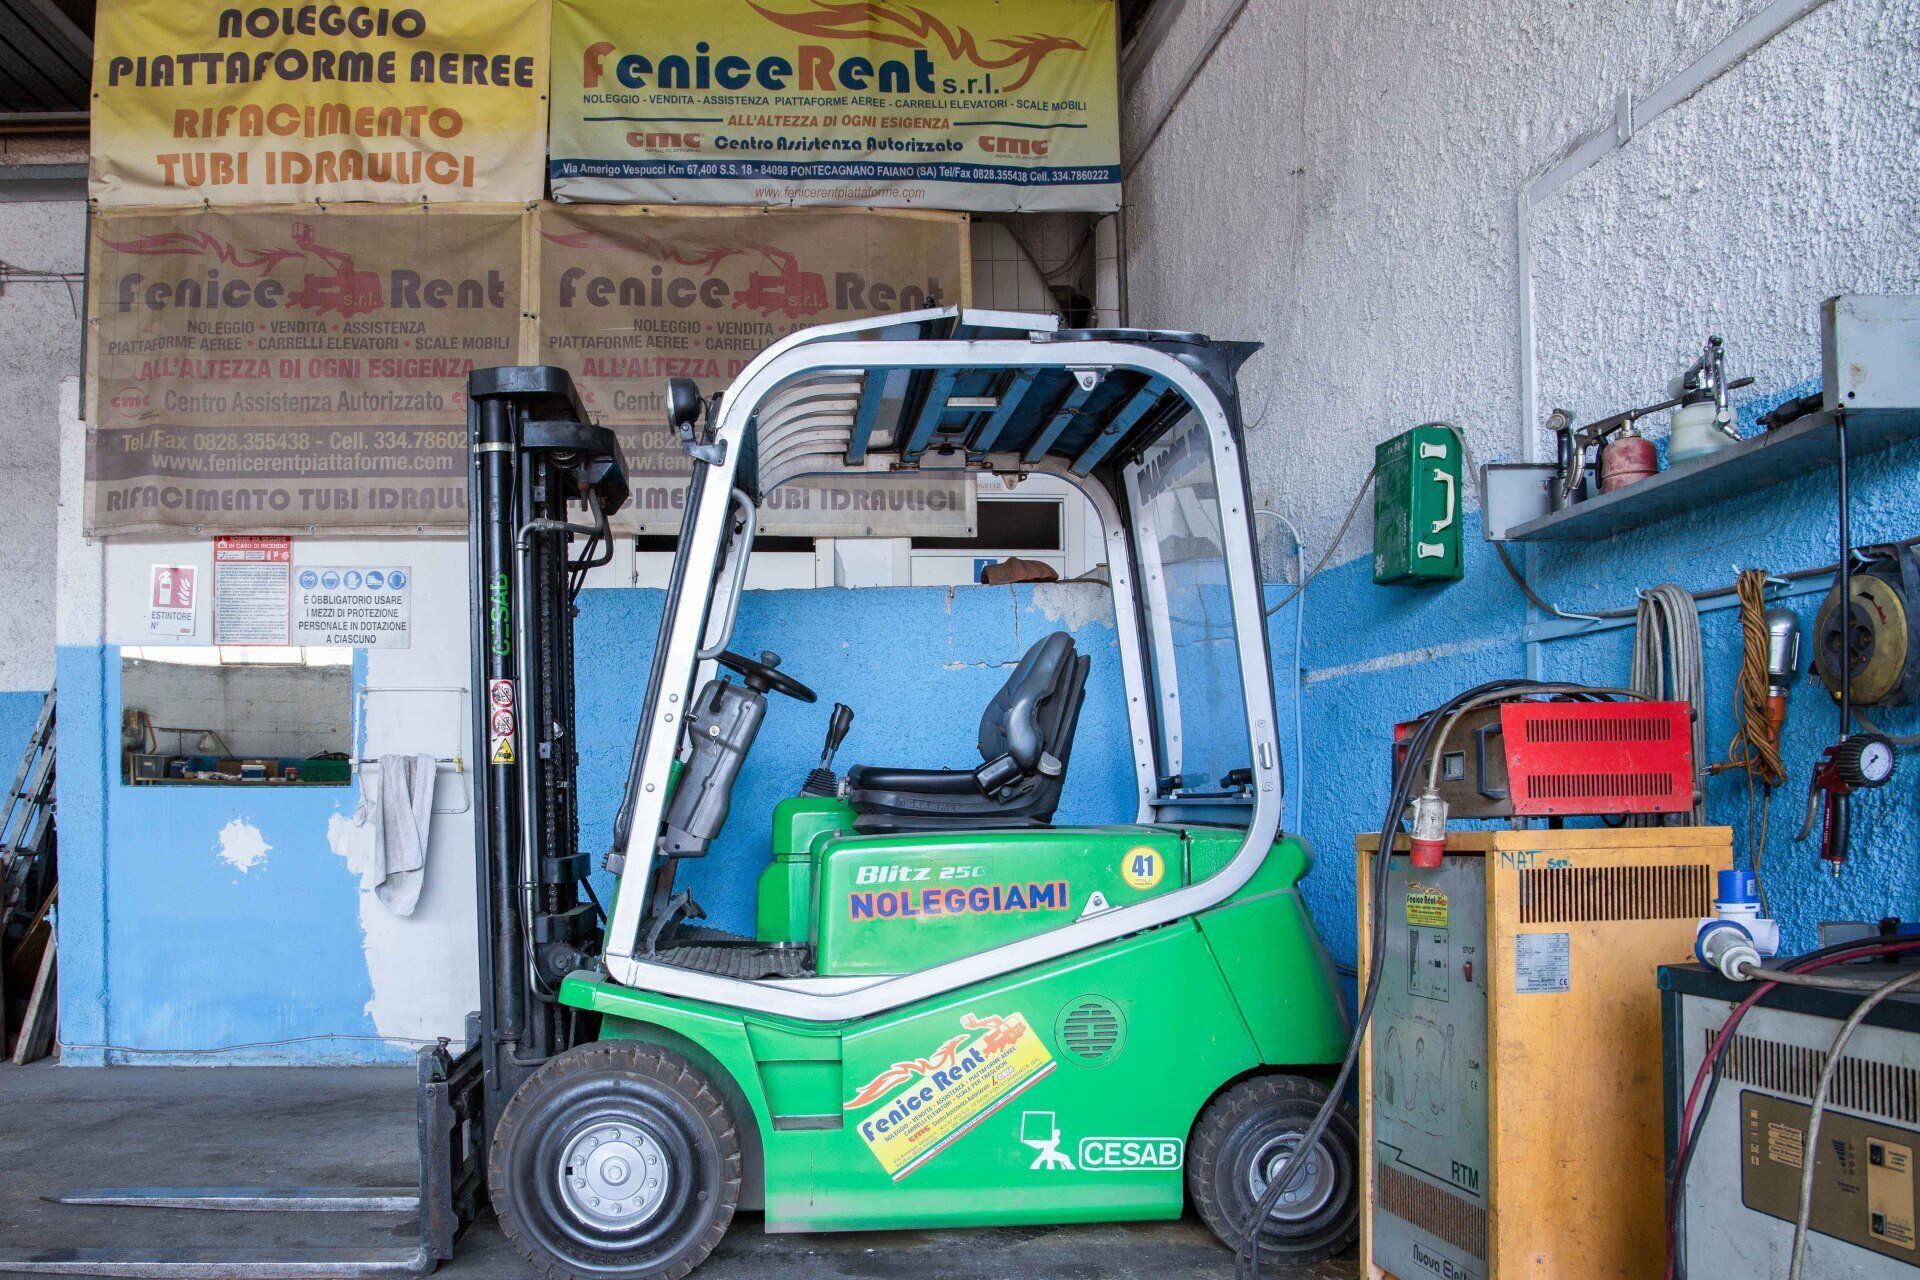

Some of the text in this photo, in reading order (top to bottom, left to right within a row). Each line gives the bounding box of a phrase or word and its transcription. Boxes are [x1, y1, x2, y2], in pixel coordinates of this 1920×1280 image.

[218, 5, 427, 39] NOLEGGIO
[109, 48, 534, 88] PIATTAFORME AEREE
[583, 94, 1087, 112] NOLEGGIO VENDITA ASSISTENZA PIATTAFORME AEREE CARRELLI ELEVATORI SCALE MOBILI
[173, 102, 463, 139] RIFACIMENTO
[727, 115, 950, 130] ALL'ALTEZZA DI OGNI ESIGENZA
[714, 135, 964, 152] Centro Assistenza Autorizzato
[157, 149, 475, 188] TUBI IDRAULICI
[563, 163, 1109, 182] Via Amerigo Vespucci Km 67,400 S.S. 18 84098 PONTECAGNANO FAIANO (SA) Tel/Fax 0828.355438 Cell. 334.7860222
[755, 186, 925, 200] www.fenicerentpiattaforme.com
[390, 269, 505, 309] Rent
[187, 320, 426, 335] NOLEGGIO VENDITA ASSISTENZA
[633, 319, 701, 334] NOLEGGIO
[717, 321, 774, 335] VENDITA
[108, 336, 510, 355] PIATTAFORME AEREE CARRELLI ELEVATORI SCALE MOBILI
[549, 335, 642, 349] PIATTAFORME
[646, 336, 689, 349] AEREE
[139, 357, 475, 381] ALL'ALTEZZA DI OGNI ESIGENZA
[582, 357, 749, 379] ALL'ALTEZZA D
[164, 389, 227, 413] Centro
[231, 391, 332, 413] Assistenza
[336, 390, 444, 412] Autorizzato
[613, 390, 668, 411] Centr
[193, 432, 310, 451] 0828.355438
[329, 431, 369, 451] Cell.
[374, 431, 468, 450] 334.78602
[152, 453, 453, 475] www.fenicerentpiattaforme.com
[107, 485, 467, 512] RIFACIMENTO TUBI IDRAUL
[766, 488, 956, 512] UBI IDRAULICI
[311, 595, 373, 605] OBBLIGATORIO
[374, 595, 402, 605] USARE
[151, 611, 192, 621] ESTINTORE
[311, 609, 335, 618] MEZZI
[337, 609, 345, 618] DI
[347, 609, 399, 618] PROTEZIONE
[298, 621, 407, 631] PERSONALE IN DOTAZIONE
[326, 635, 377, 644] A CIASCUNO
[1132, 855, 1154, 877] 41
[1501, 849, 1543, 870] NAT
[856, 865, 932, 885] Blitz
[850, 883, 1067, 919] NOLEGGIAMI
[1462, 946, 1476, 955] STOP
[930, 1044, 986, 1092] Rent
[884, 1122, 909, 1143] NOLEGGIO
[911, 1105, 933, 1123] VENDITA
[934, 1081, 965, 1106] ASSISTENZA
[968, 1055, 1001, 1082] PIATTAFORME
[999, 1044, 1017, 1059] AEREE
[903, 1117, 928, 1137] CARRELLI
[926, 1099, 952, 1120] ELEVATORI
[955, 1085, 971, 1100] SCALE
[970, 1078, 982, 1088] PER
[980, 1059, 1008, 1081] TRASLOCHI
[944, 1098, 968, 1117] Assistenza
[1084, 1142, 1177, 1166] CESAB
[1451, 1159, 1479, 1190] RTM
[1413, 1243, 1440, 1273] Nuova
